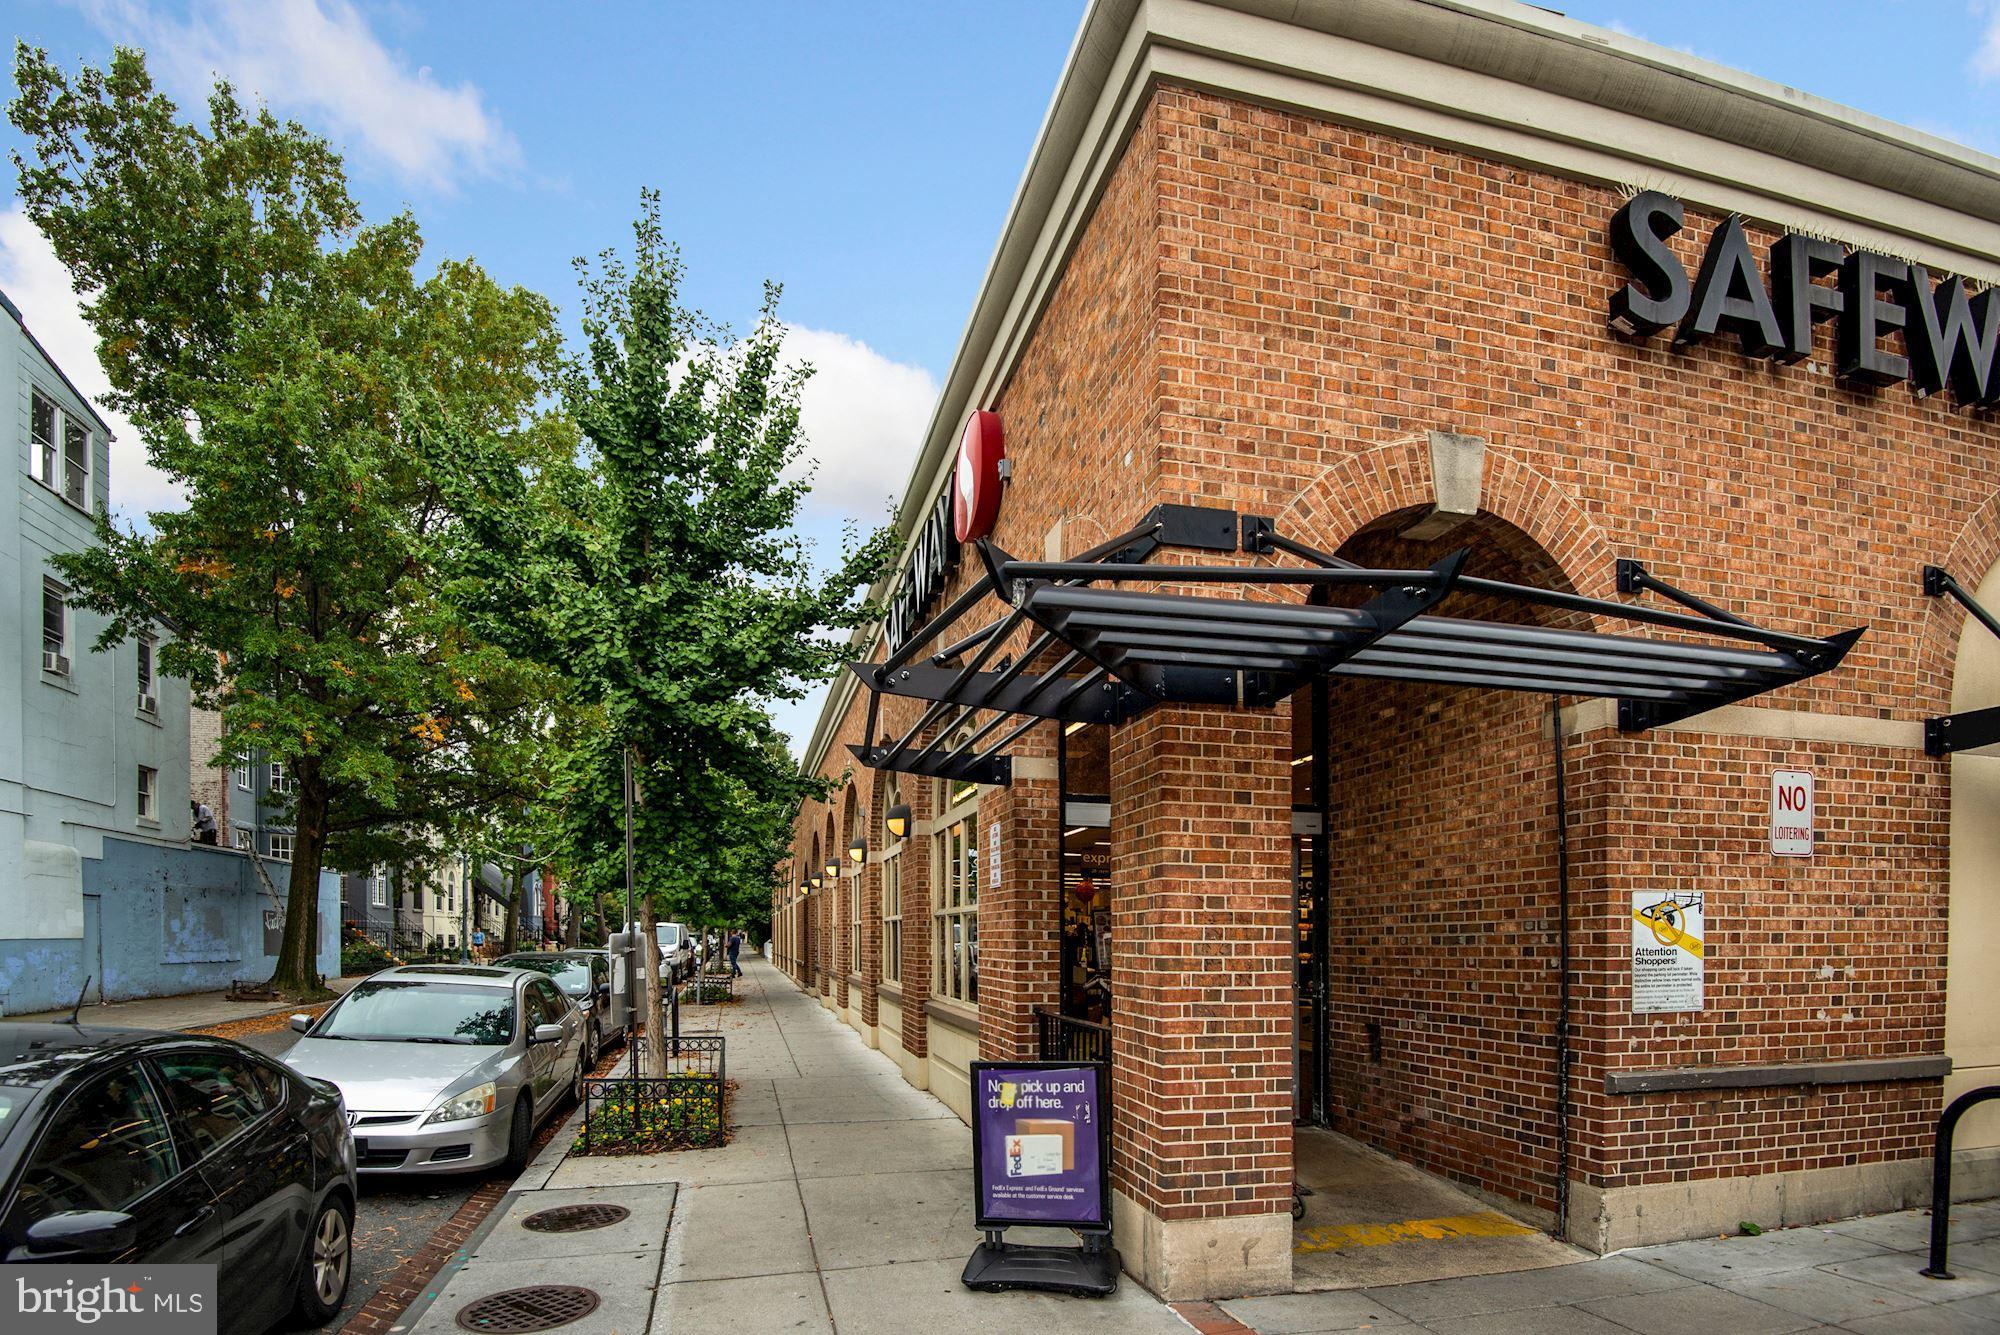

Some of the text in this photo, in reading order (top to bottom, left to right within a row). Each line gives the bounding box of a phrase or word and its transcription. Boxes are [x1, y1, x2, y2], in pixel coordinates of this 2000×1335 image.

[1778, 785, 1806, 812] NO
[1774, 826, 1810, 841] LOITERING
[1635, 946, 1678, 957] Attention
[1021, 1079, 1043, 1096] pick
[1046, 1083, 1061, 1096] up
[1063, 1080, 1085, 1093] and
[1016, 1095, 1033, 1109] off
[1035, 1096, 1064, 1109] here.
[1010, 1139, 1022, 1176] FedEx
